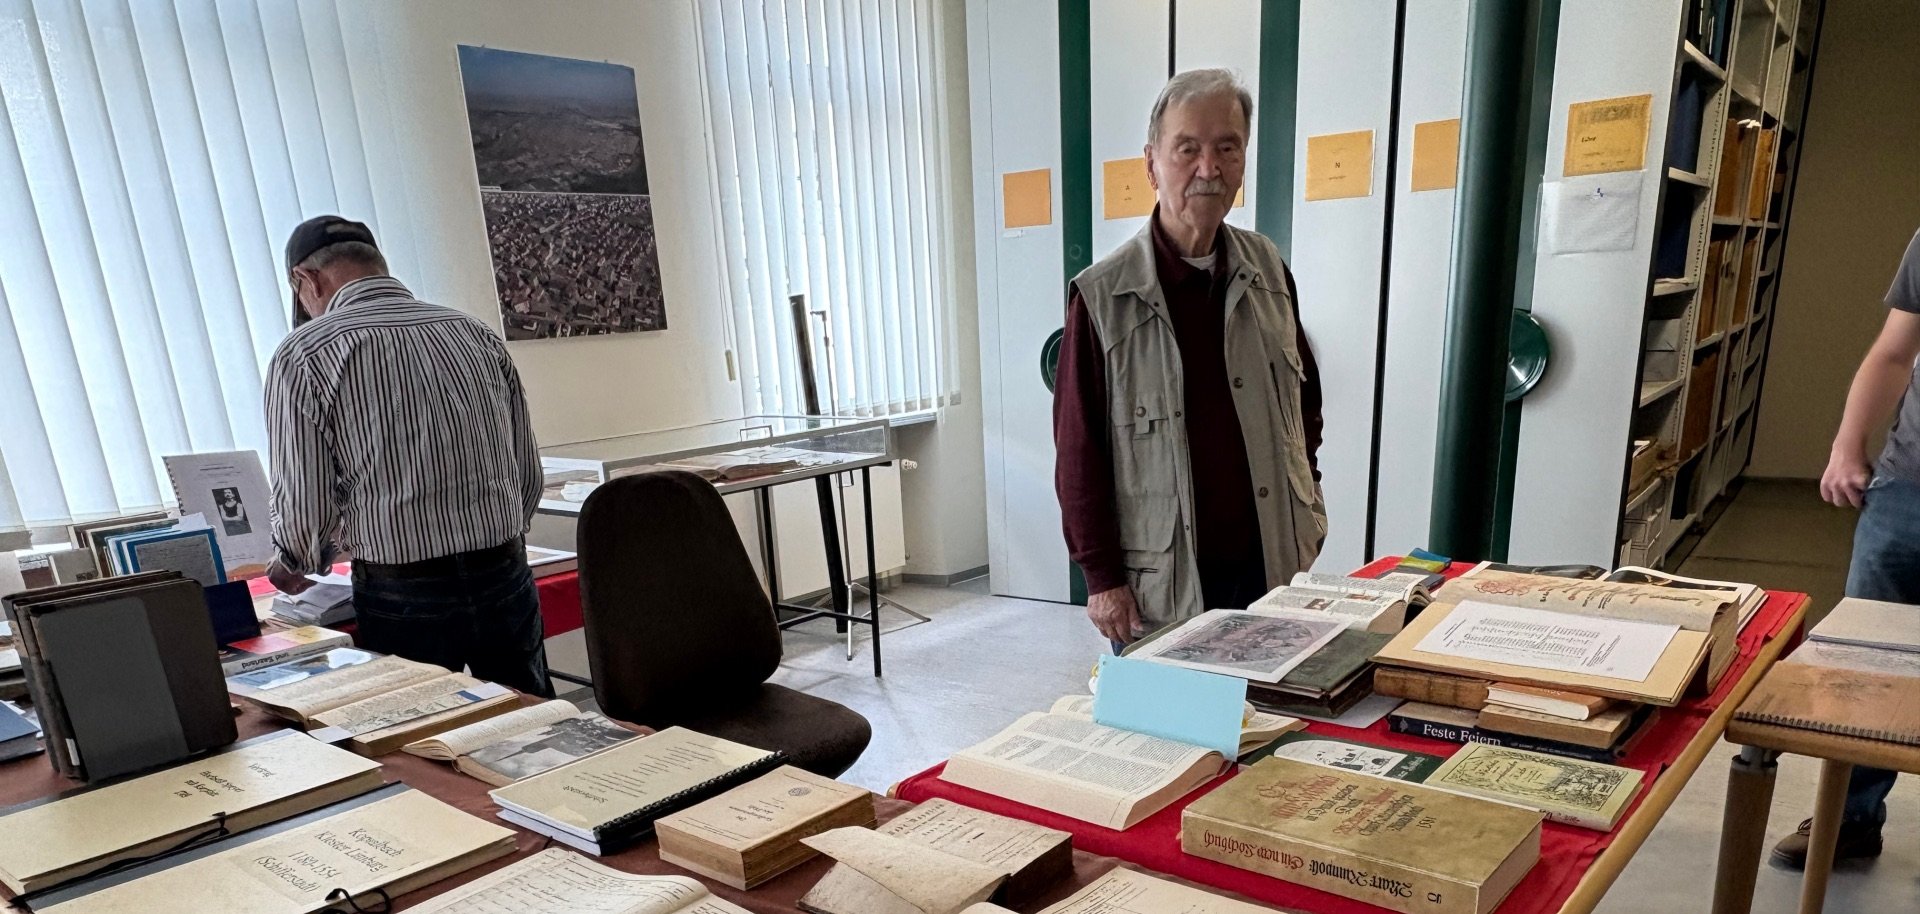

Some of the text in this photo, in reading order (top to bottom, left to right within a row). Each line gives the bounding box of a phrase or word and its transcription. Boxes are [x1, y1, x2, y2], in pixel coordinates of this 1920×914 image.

[1424, 724, 1502, 747] Feste Feiern
[314, 830, 389, 872] Kloster Limburg
[1203, 829, 1257, 858] Kochbuch
[253, 856, 322, 893] (Schifferstadt)
[1284, 854, 1304, 870] Ein
